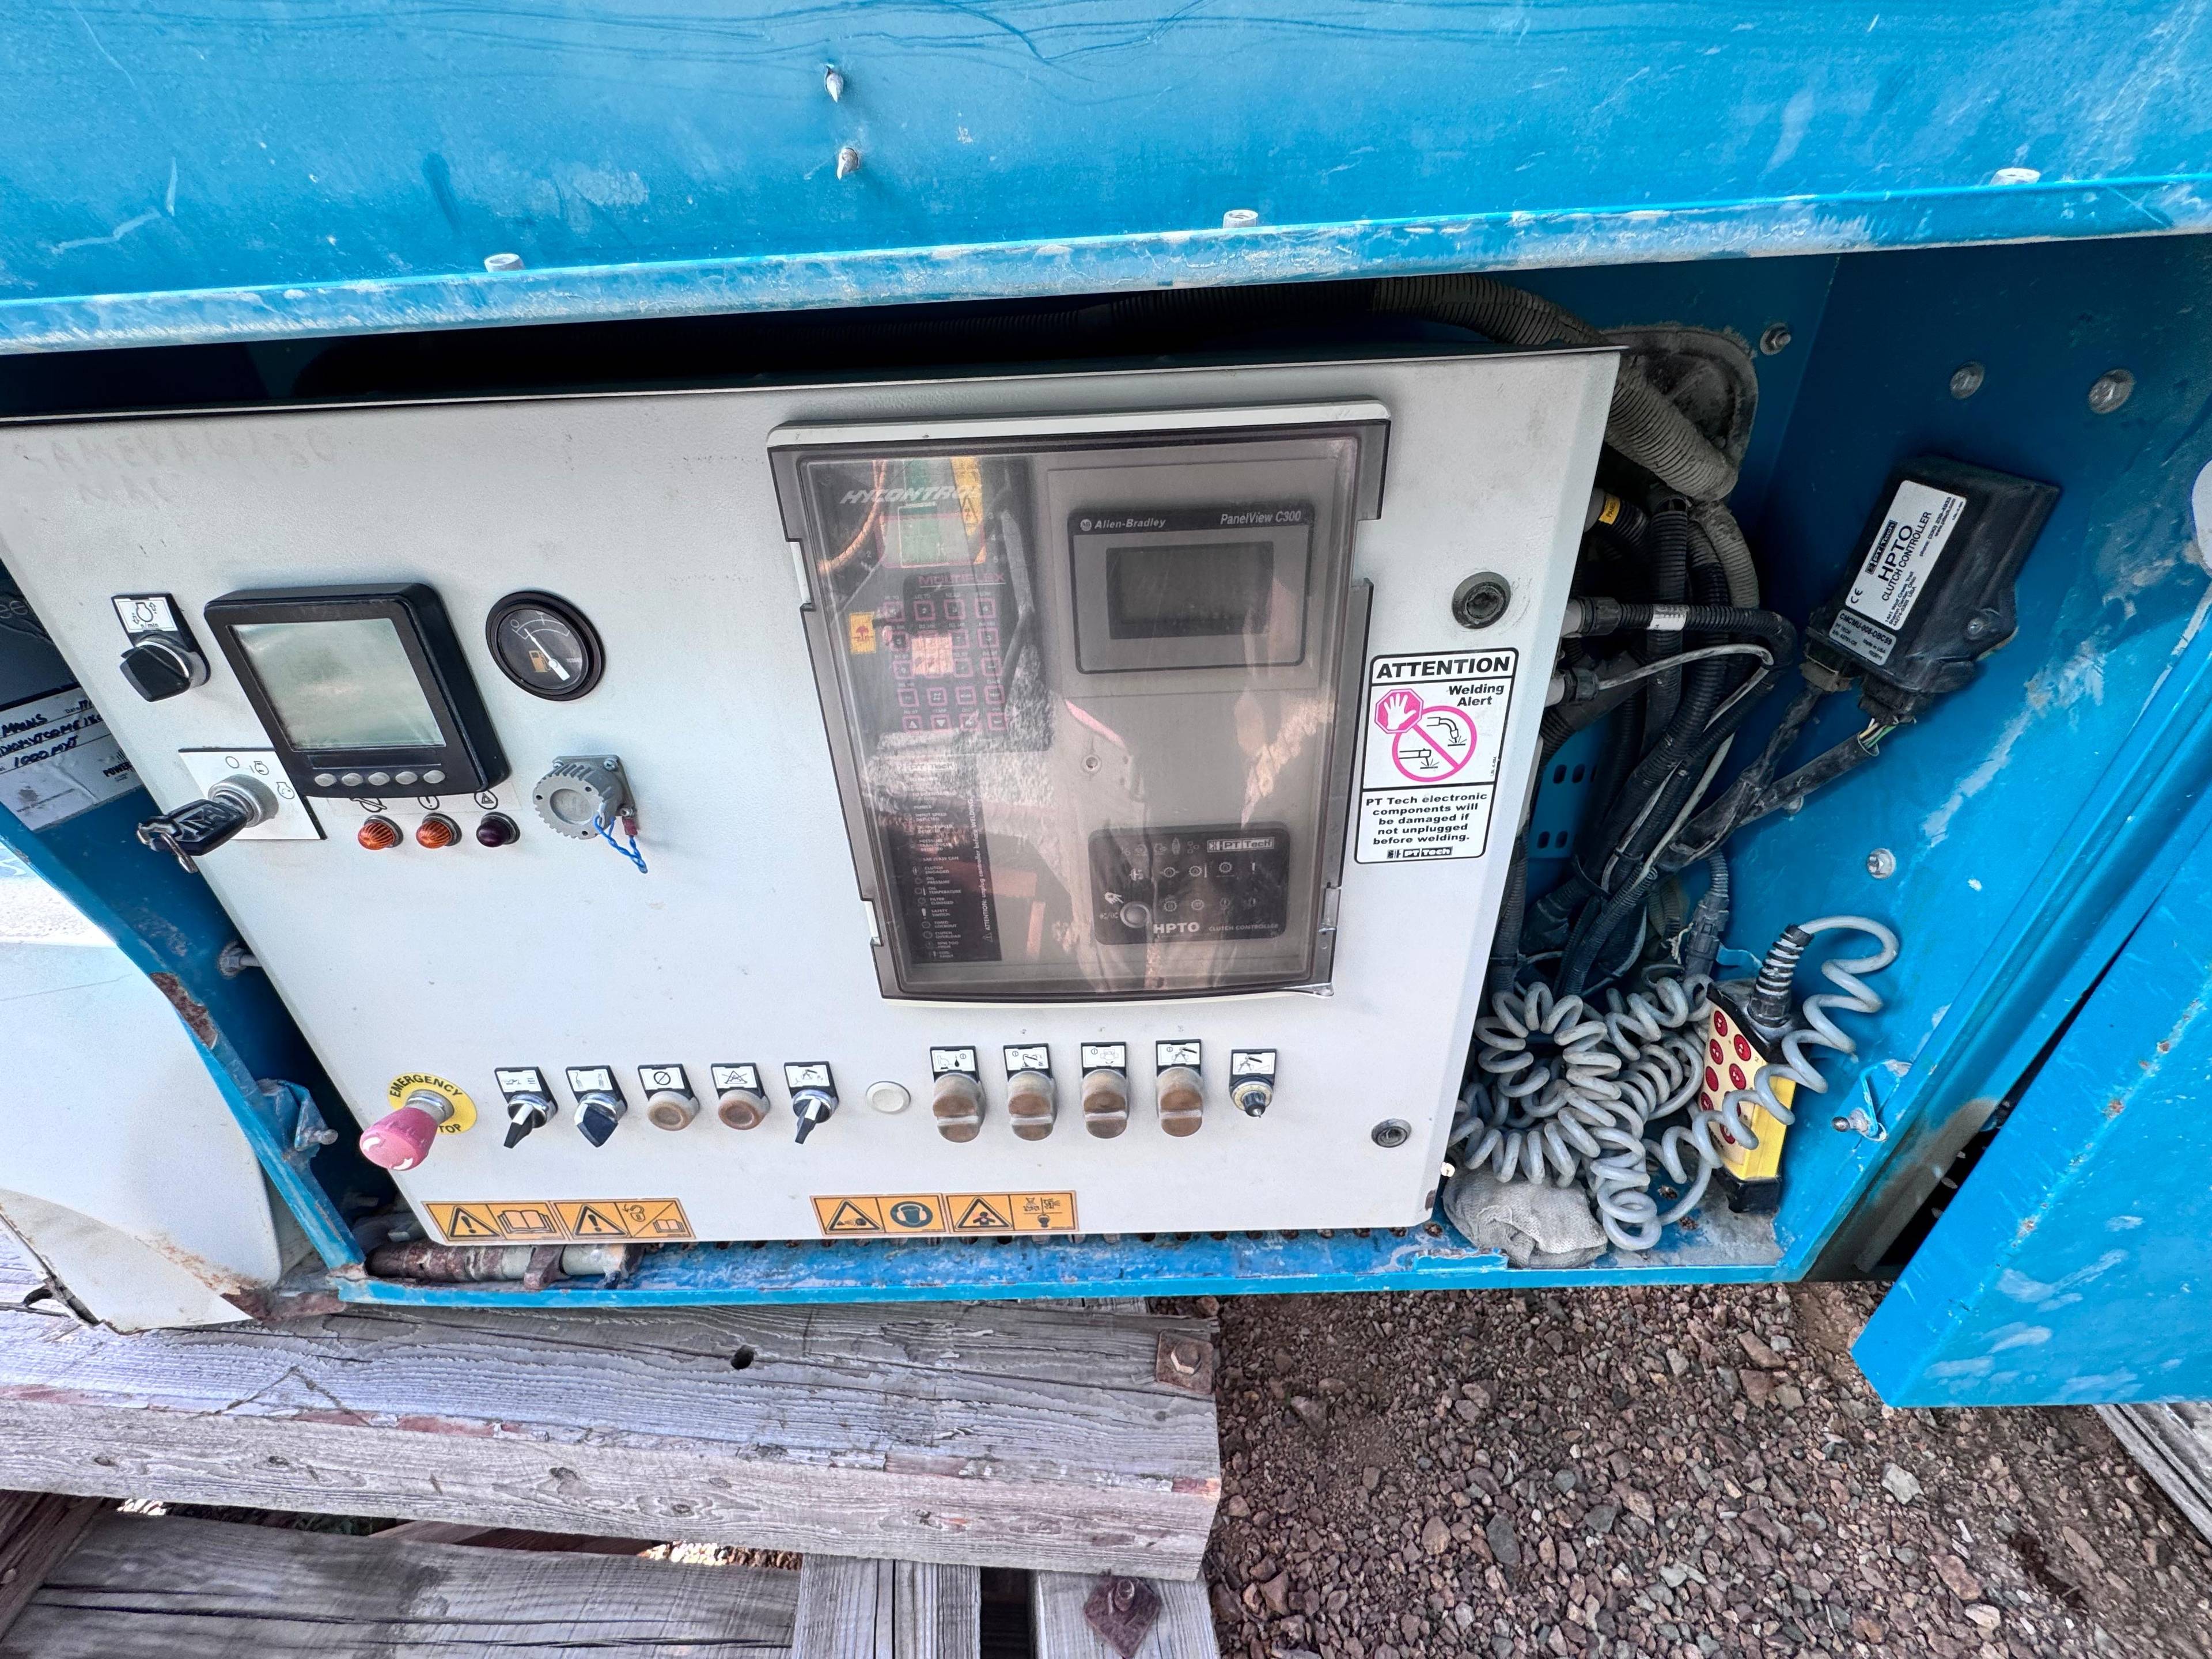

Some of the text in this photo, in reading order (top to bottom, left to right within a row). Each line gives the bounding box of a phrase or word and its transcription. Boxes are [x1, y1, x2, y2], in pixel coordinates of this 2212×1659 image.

[1094, 518, 1166, 530] Allen-Bradley
[1220, 510, 1301, 526] PanelView C300
[1878, 525, 1912, 581] HPTO
[1882, 512, 1932, 601] CLUTCH CONTROLLER
[1377, 656, 1510, 679] ATTENTION
[1449, 684, 1504, 695] Welding
[1457, 696, 1493, 707] Alert
[1387, 797, 1417, 805] Tech
[1422, 793, 1487, 803] electronic
[1373, 805, 1450, 817] components
[1398, 814, 1456, 825] damaged
[1403, 824, 1468, 835] unplugged
[1224, 839, 1272, 849] PT Tech
[1373, 834, 1469, 845] before welding.
[1422, 847, 1452, 856] Tech
[975, 850, 983, 877] controller
[979, 877, 987, 897] unplug
[982, 899, 991, 931] ATTENTION:
[1154, 922, 1200, 934] HPTO
[1235, 923, 1279, 931] CONTROLLER
[389, 1074, 463, 1098] EMERGENCY
[438, 1123, 461, 1133] TOP
